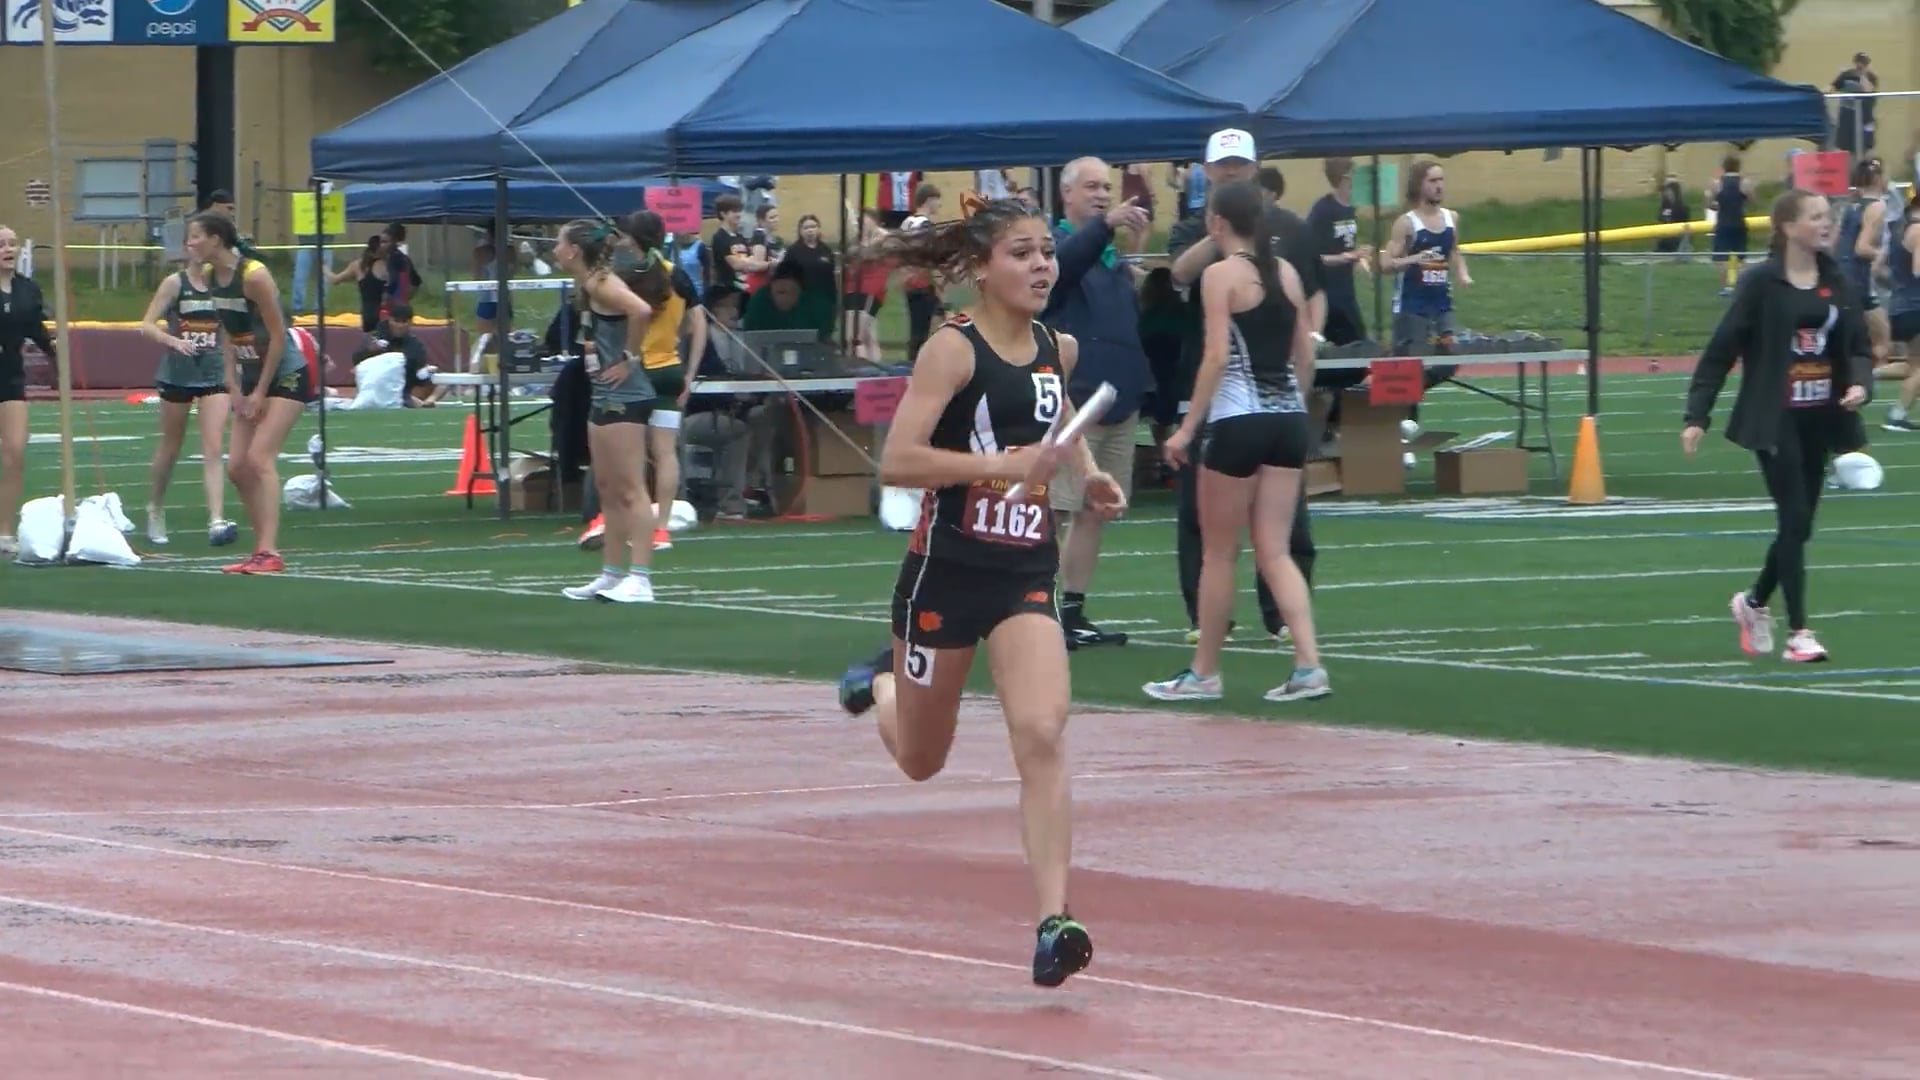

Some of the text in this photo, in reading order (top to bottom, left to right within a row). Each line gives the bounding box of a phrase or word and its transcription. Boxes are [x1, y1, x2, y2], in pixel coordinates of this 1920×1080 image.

[146, 19, 197, 38] pepsi
[1038, 376, 1059, 419] 5
[972, 497, 1042, 540] 1162
[907, 643, 927, 679] 5
